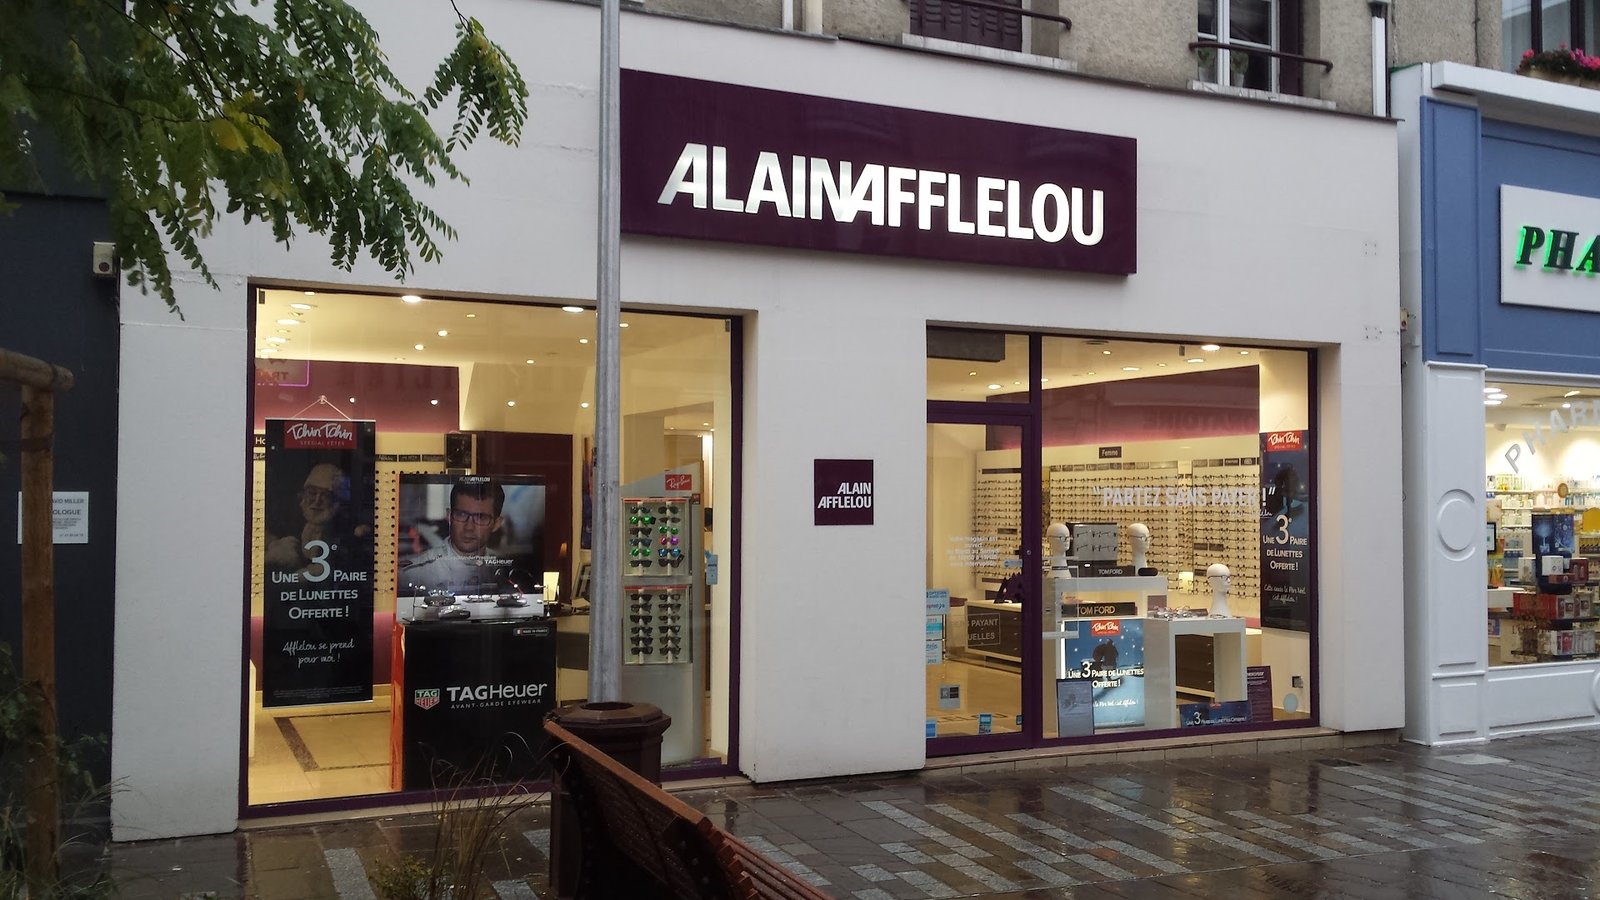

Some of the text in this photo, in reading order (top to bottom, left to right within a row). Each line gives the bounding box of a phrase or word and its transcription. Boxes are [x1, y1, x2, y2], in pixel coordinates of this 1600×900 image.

[1516, 226, 1600, 273] PHA
[837, 482, 872, 495] ALAIN
[817, 495, 872, 509] AFFLELOU
[1165, 486, 1208, 507] SANS
[1262, 534, 1275, 545] UNE
[1289, 535, 1308, 546] PAIRE
[1274, 548, 1304, 559] LUNETTES
[271, 571, 300, 584] UNE
[333, 569, 367, 583] PAIRE
[299, 588, 359, 601] LUNETTES
[288, 606, 343, 620] OFFERTE
[1077, 605, 1116, 615] TOM FORD
[971, 618, 999, 627] PAYANT
[329, 638, 355, 654] prend
[1116, 668, 1145, 677] LUNETTES
[417, 690, 438, 698] TAG
[415, 697, 438, 707] HEUER
[450, 698, 542, 710] AVANT-GARDE EYEWEAR
